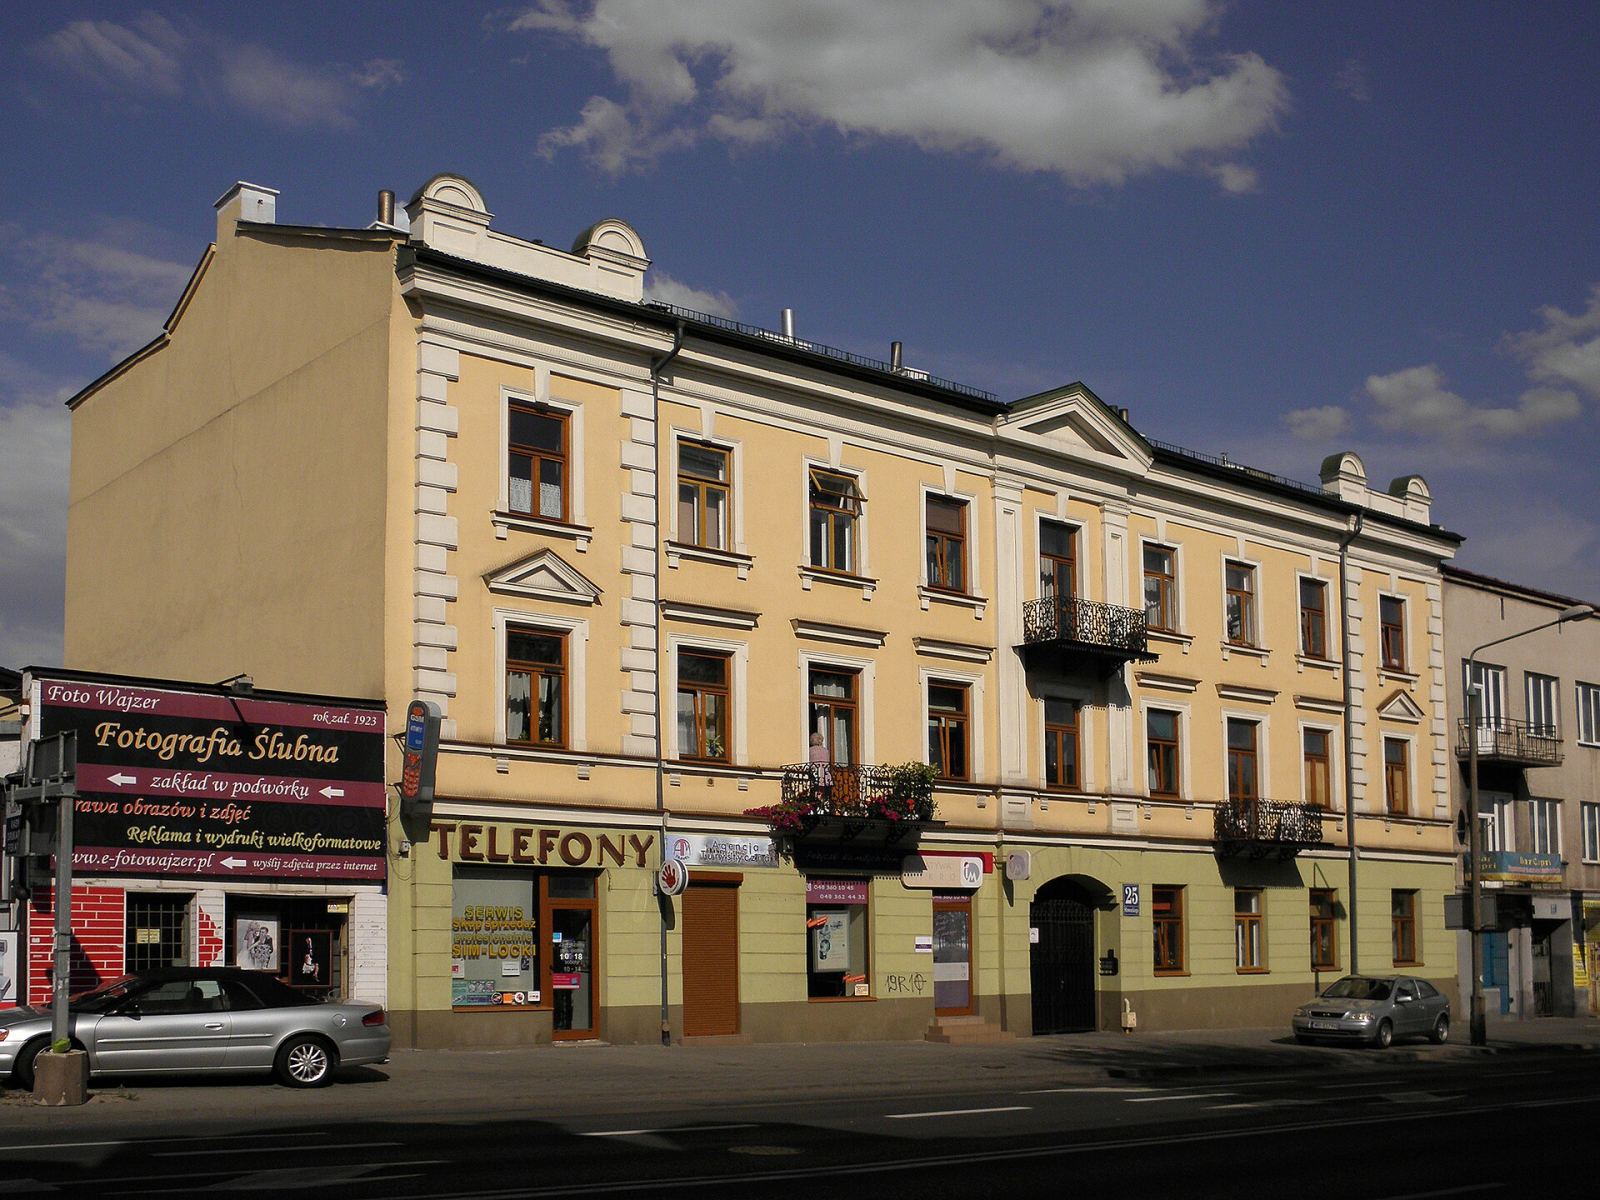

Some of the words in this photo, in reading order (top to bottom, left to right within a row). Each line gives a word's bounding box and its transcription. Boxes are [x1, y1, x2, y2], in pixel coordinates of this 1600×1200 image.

[48, 685, 91, 704] Foto
[95, 689, 161, 713] Wajzer
[313, 711, 332, 725] rok
[332, 713, 350, 725] zał.
[353, 715, 377, 727] 1923
[95, 722, 243, 764] Fotografia
[248, 727, 339, 764] Ślubna
[149, 772, 212, 795] zakład
[212, 778, 228, 792] w
[230, 778, 310, 800] podwórku
[74, 799, 120, 815] rawa
[122, 797, 197, 818] obrazów
[199, 803, 207, 819] i
[209, 803, 252, 825] zdjęć
[126, 825, 192, 845] Reklama
[195, 829, 203, 844] i
[204, 829, 265, 849] wydruki
[266, 832, 382, 852] wielkoformatowe
[429, 823, 655, 868] TELEFONY
[712, 840, 759, 854] Agencja
[252, 858, 282, 872] wyślij
[282, 858, 315, 872] zdjęcia
[315, 862, 341, 872] przez
[343, 861, 378, 872] internet
[1125, 886, 1139, 905] 25
[465, 904, 524, 920] SERWIS
[560, 952, 570, 960] 10
[574, 952, 583, 960] 18
